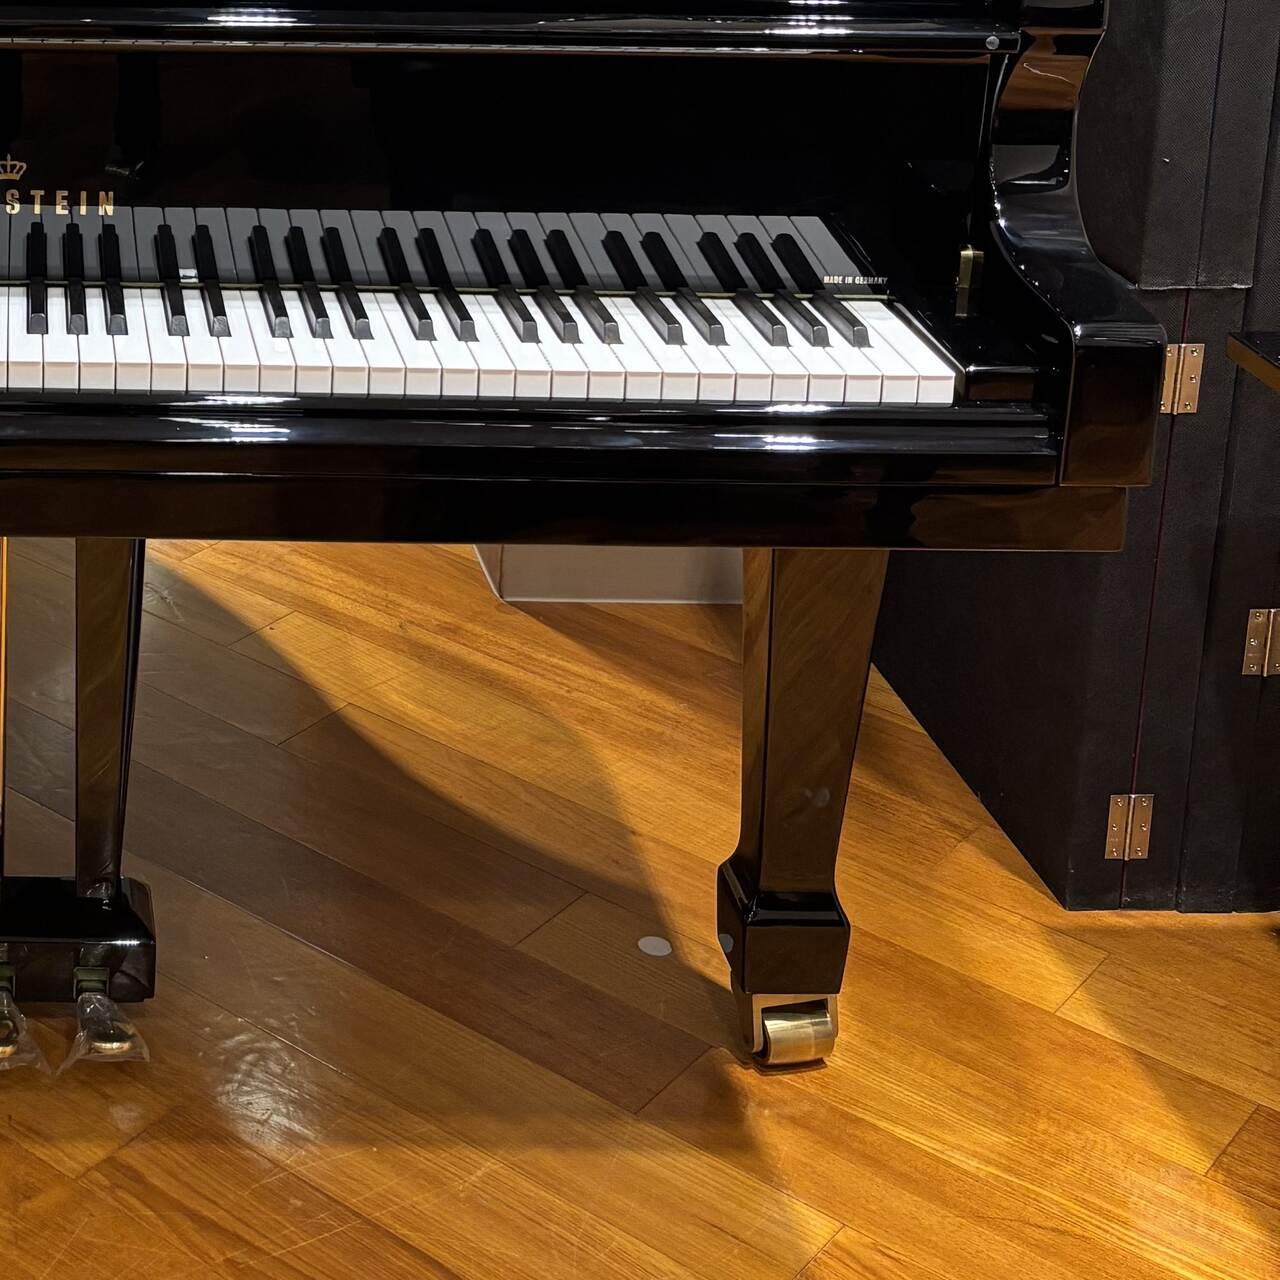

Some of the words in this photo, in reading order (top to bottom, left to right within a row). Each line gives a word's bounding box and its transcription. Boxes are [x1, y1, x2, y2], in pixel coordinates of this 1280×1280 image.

[823, 276, 843, 284] MADE
[845, 276, 853, 284] IN
[855, 276, 888, 285] GERMANY
